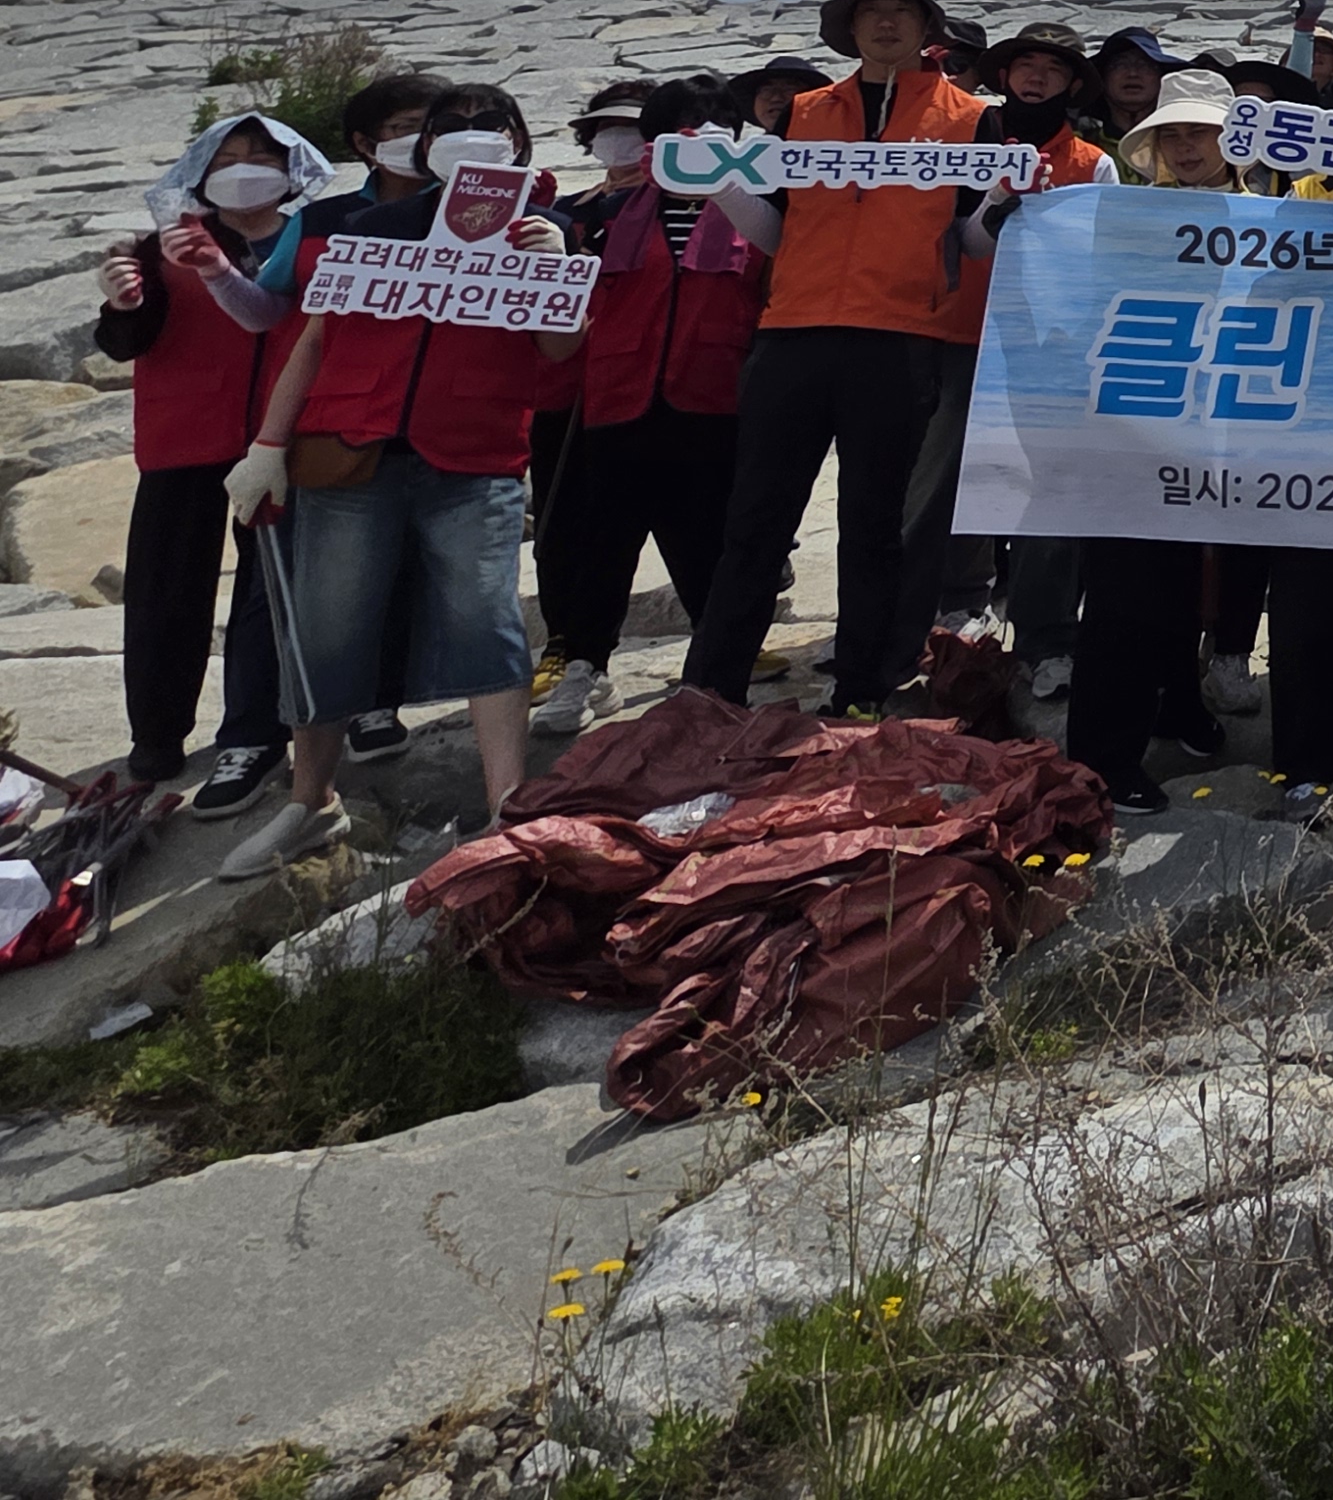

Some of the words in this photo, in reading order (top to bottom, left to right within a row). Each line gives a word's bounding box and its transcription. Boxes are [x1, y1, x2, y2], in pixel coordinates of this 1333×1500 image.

[460, 173, 484, 184] KU
[662, 142, 771, 186] LX
[781, 149, 1032, 182] 한국국토정보공사
[456, 185, 517, 200] MEDICINE
[322, 238, 596, 285] 고려대학교의료원
[310, 290, 350, 310] 협력
[314, 272, 355, 292] 교류
[363, 278, 584, 328] 대자인병원
[1095, 298, 1315, 421] 클린
[1158, 466, 1243, 509] 일시:
